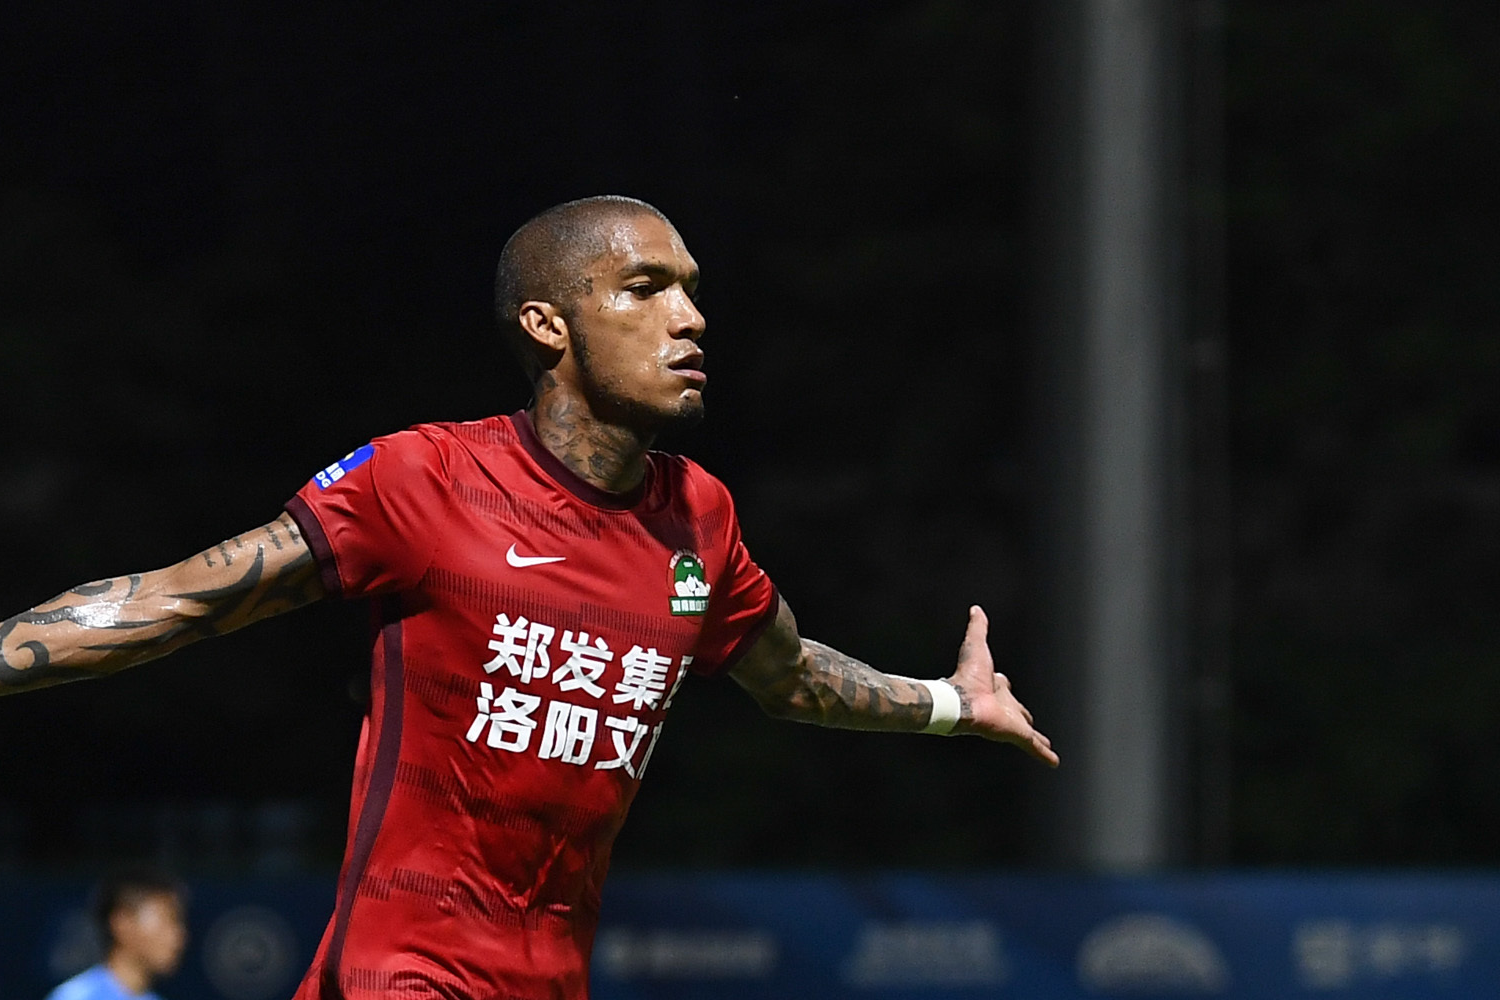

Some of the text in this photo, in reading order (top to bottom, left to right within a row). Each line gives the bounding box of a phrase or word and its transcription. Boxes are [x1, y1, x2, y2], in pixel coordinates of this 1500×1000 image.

[483, 613, 694, 712] 郑发集
[466, 682, 663, 780] 洛阳文
